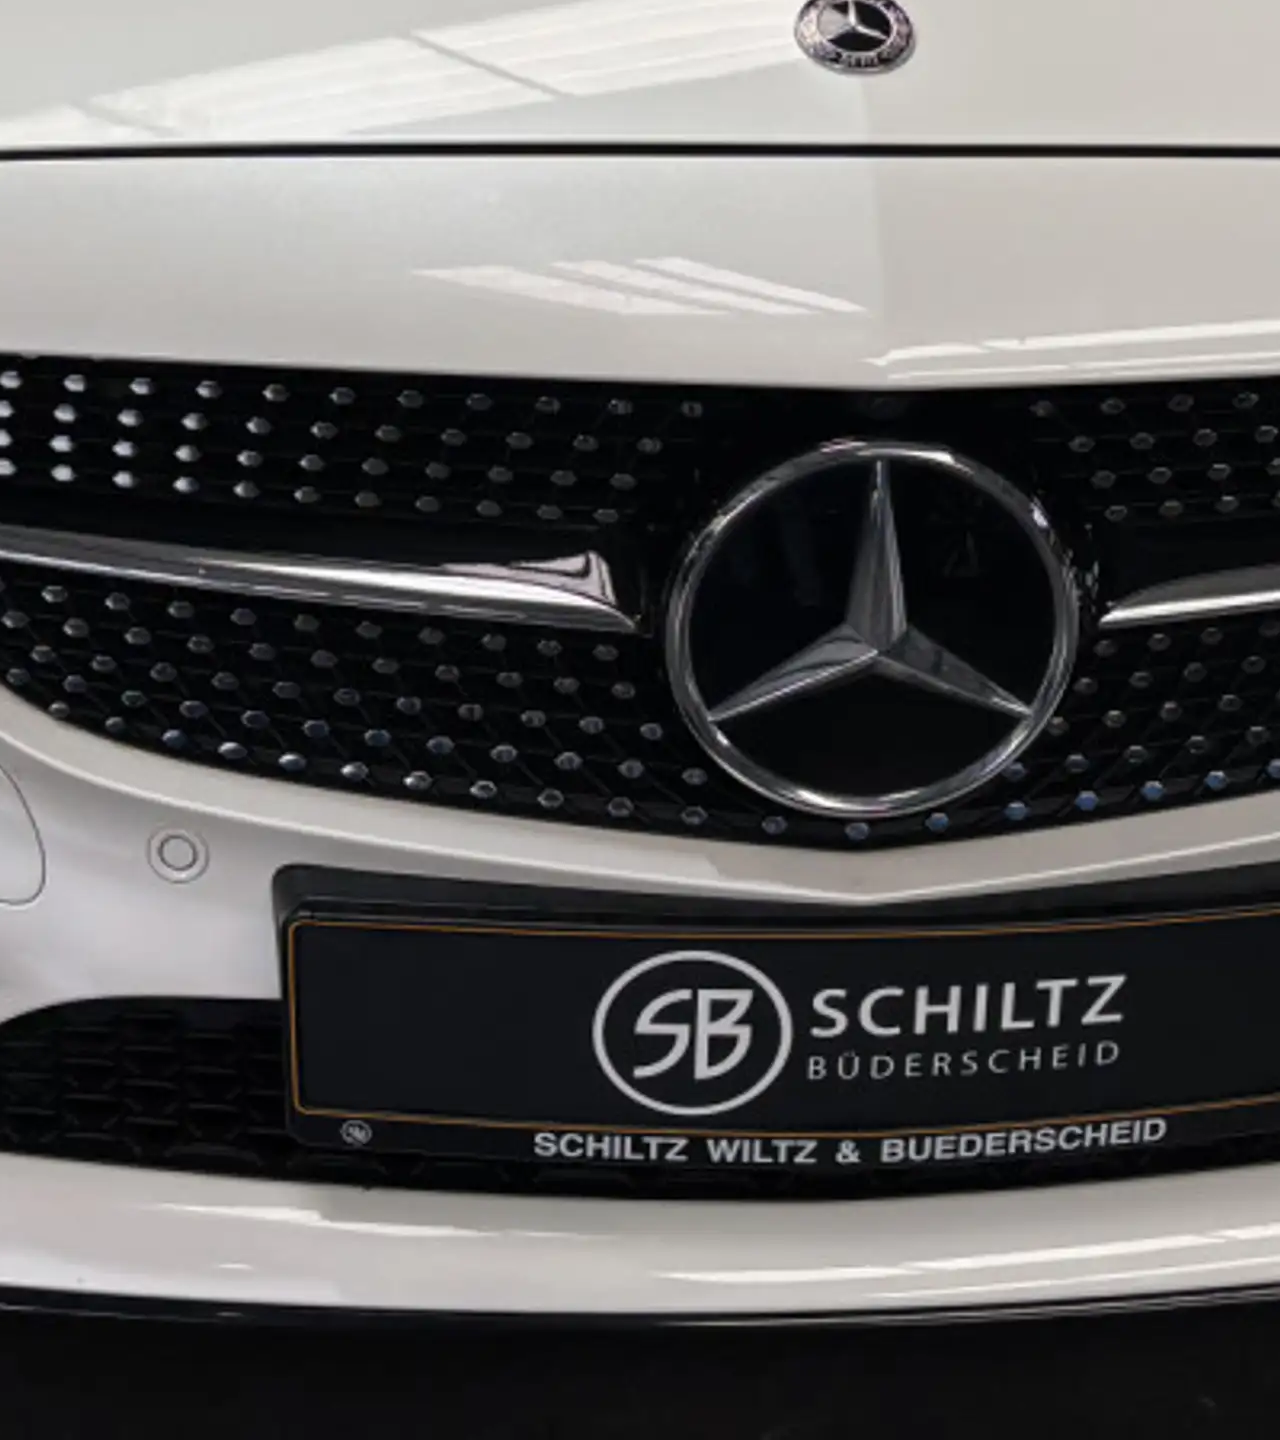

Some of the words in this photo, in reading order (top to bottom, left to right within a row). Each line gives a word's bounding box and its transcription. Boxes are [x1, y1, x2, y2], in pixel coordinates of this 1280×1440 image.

[632, 987, 756, 1082] SB
[808, 974, 1127, 1039] SCHILTZ
[806, 1040, 1121, 1081] BÜDERSCHEID
[533, 1131, 689, 1162] SCHILTZ
[706, 1138, 818, 1164] WILTZ
[834, 1139, 861, 1166] &
[879, 1116, 1167, 1164] BUEDERSCHEID
